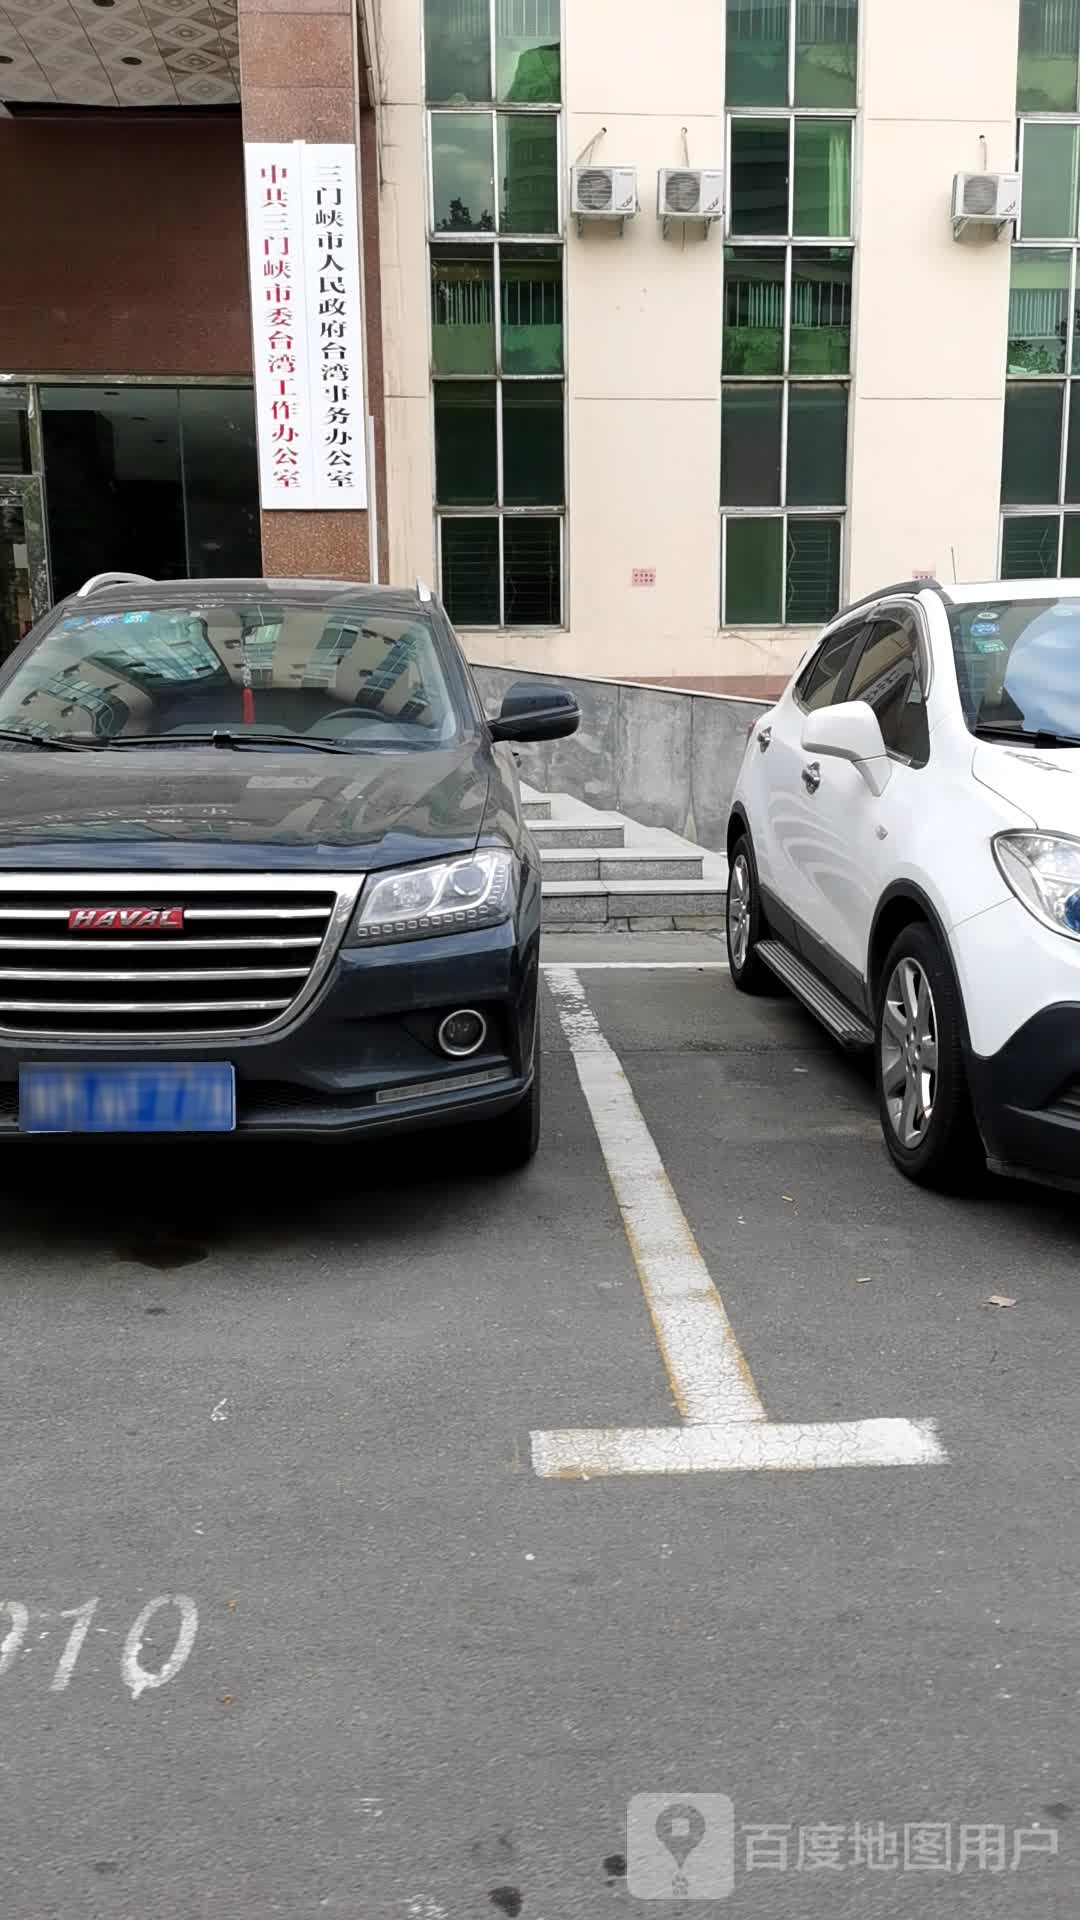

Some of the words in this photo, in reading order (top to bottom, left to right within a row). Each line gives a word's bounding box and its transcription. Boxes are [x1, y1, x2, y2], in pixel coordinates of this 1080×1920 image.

[260, 164, 301, 489] 中共三门峡市委台湾工作办公室
[313, 164, 354, 488] 三门峡市人民政府台湾事务办公室
[72, 909, 178, 928] HAVAL
